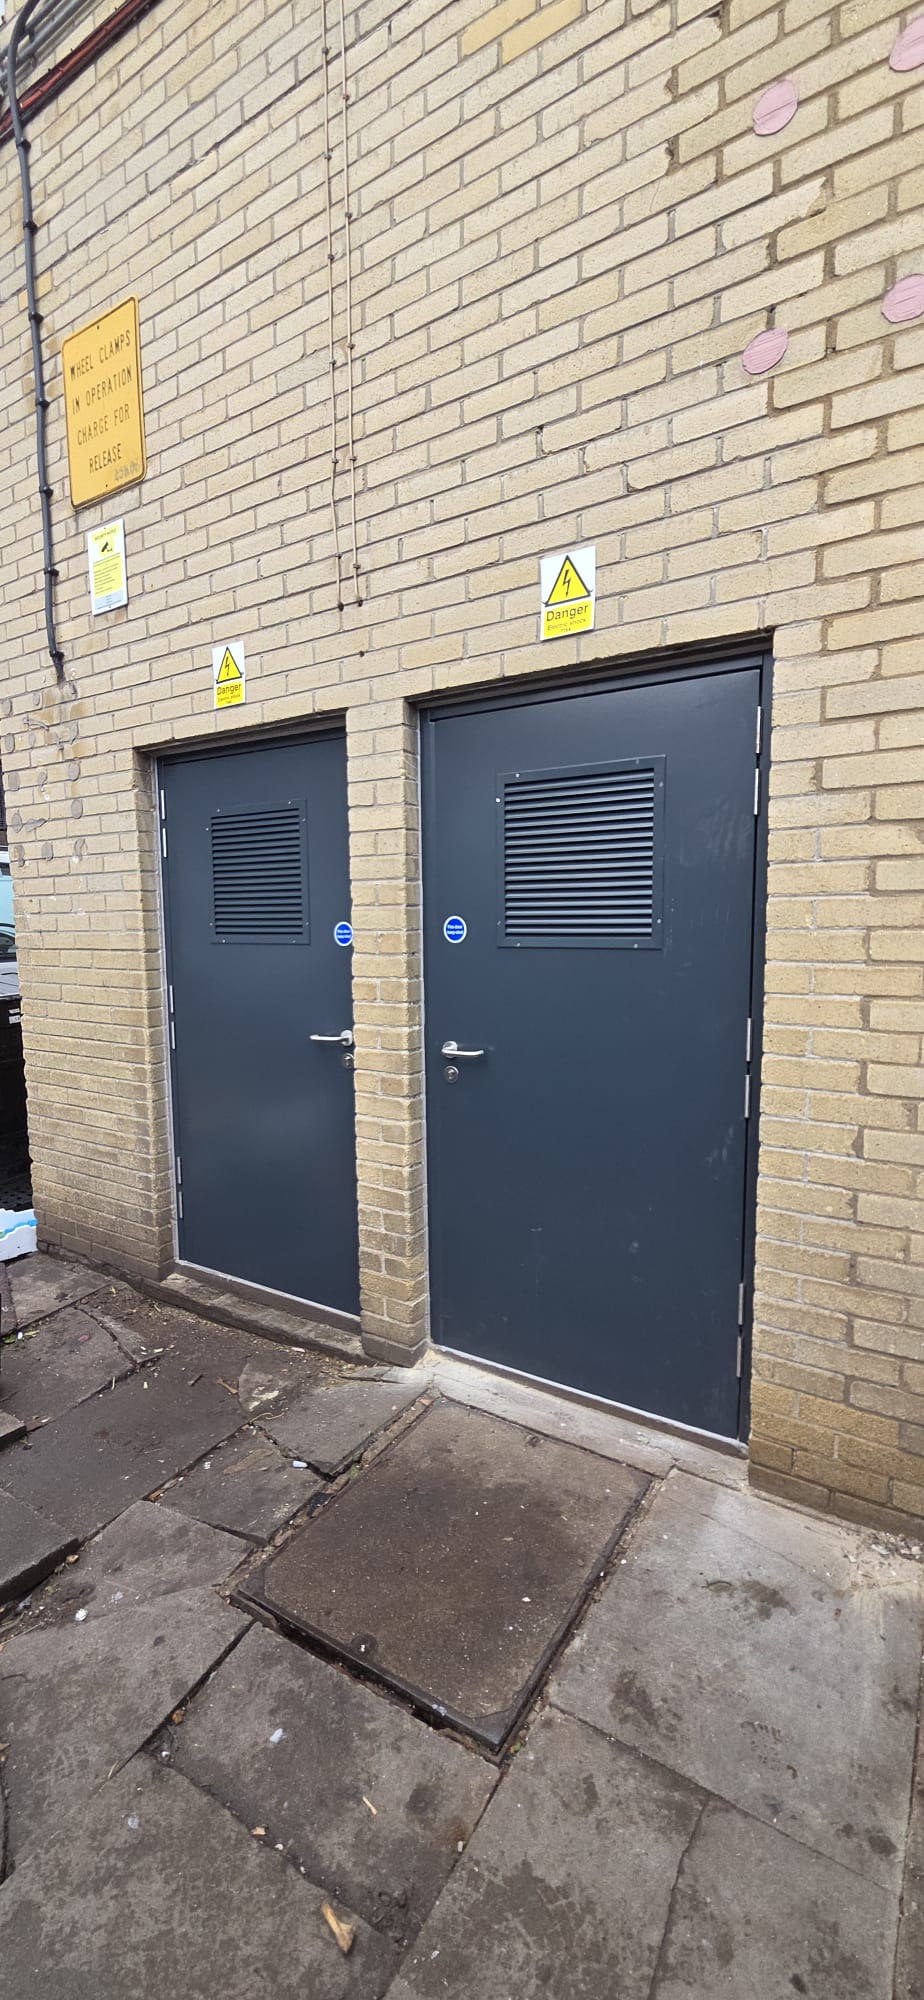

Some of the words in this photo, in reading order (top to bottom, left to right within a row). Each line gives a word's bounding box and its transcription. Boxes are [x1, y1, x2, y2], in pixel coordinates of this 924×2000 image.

[70, 355, 94, 381] WHEEL
[99, 329, 131, 364] CLAMPS
[72, 396, 81, 415] IN
[85, 365, 133, 407] OPERATION
[77, 415, 109, 446] CHARGE
[114, 403, 131, 427] FOR
[89, 443, 122, 474] RELEASE
[546, 605, 588, 621] Danger
[216, 684, 241, 695] Danger
